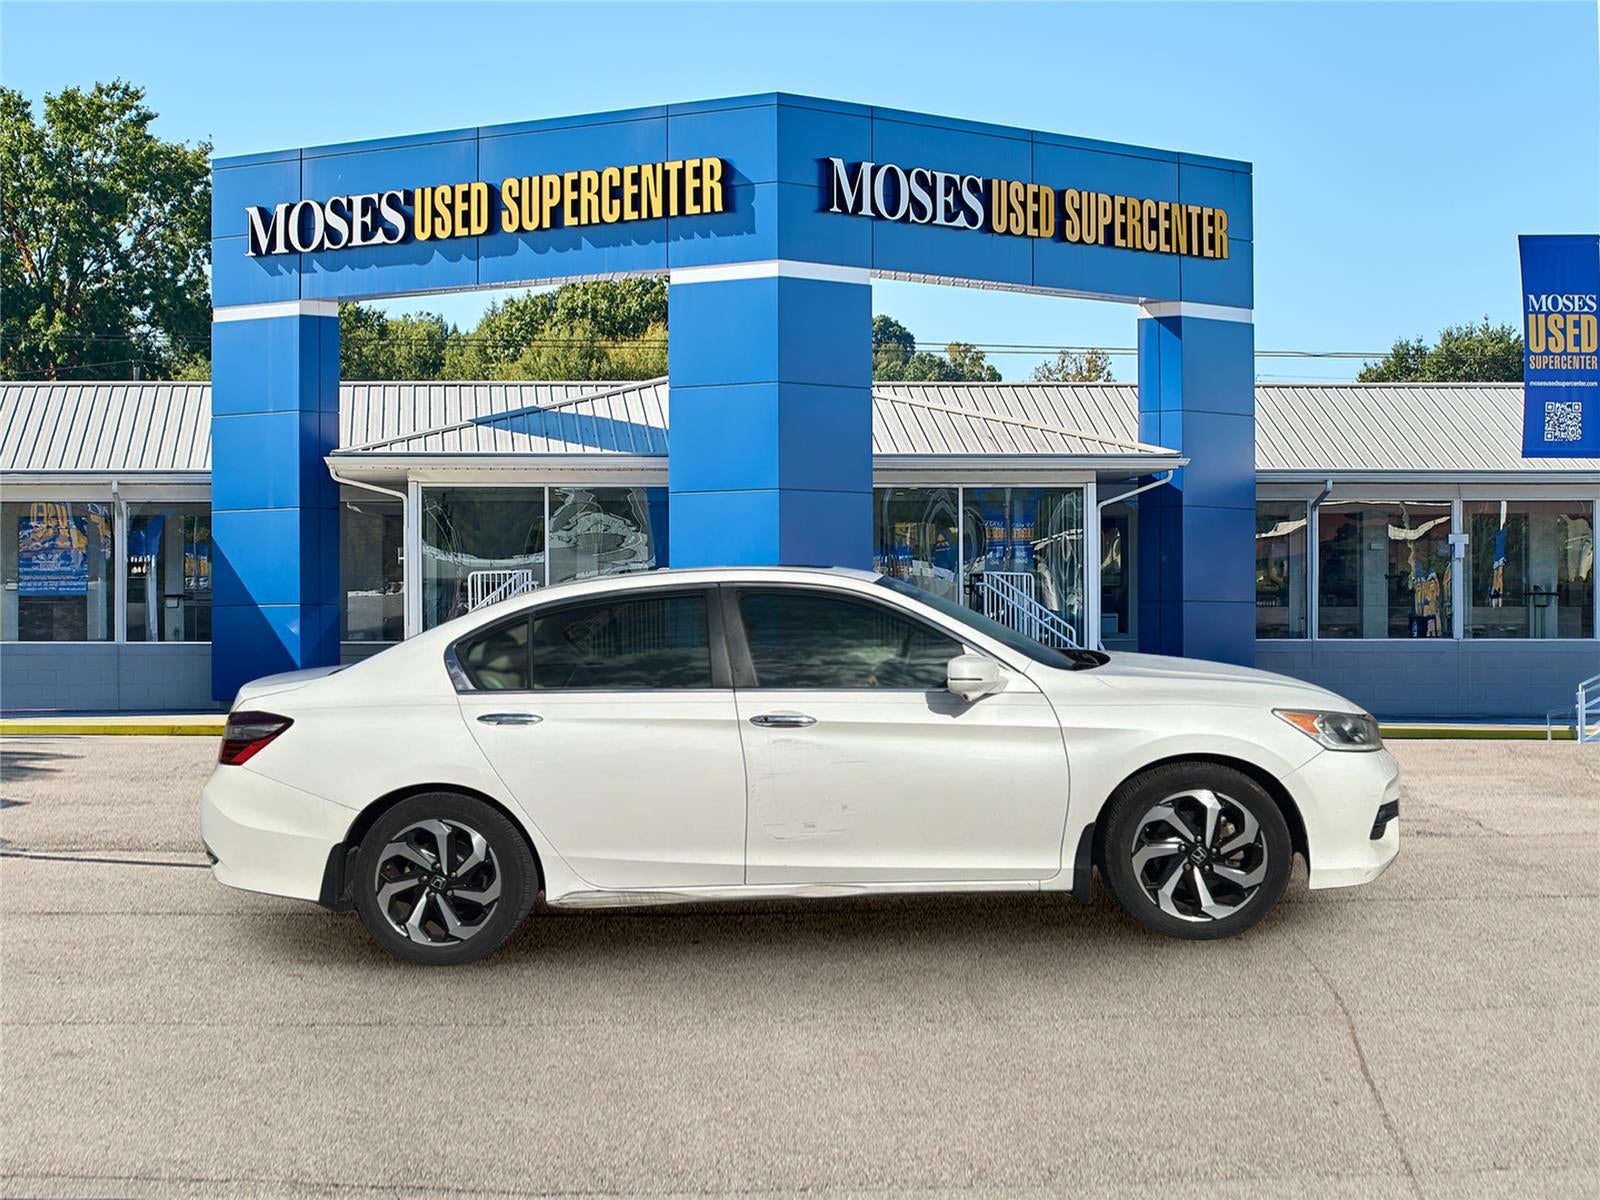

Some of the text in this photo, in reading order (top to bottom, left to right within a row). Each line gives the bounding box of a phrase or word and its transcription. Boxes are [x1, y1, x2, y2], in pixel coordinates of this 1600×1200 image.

[244, 157, 723, 257] MOSES USED SUPERCENTER
[828, 157, 1230, 260] MOSES USED SUPERCENTER
[1527, 294, 1597, 312] MOSES
[1528, 314, 1598, 353] USED
[1529, 355, 1598, 369] SUPERCENTER
